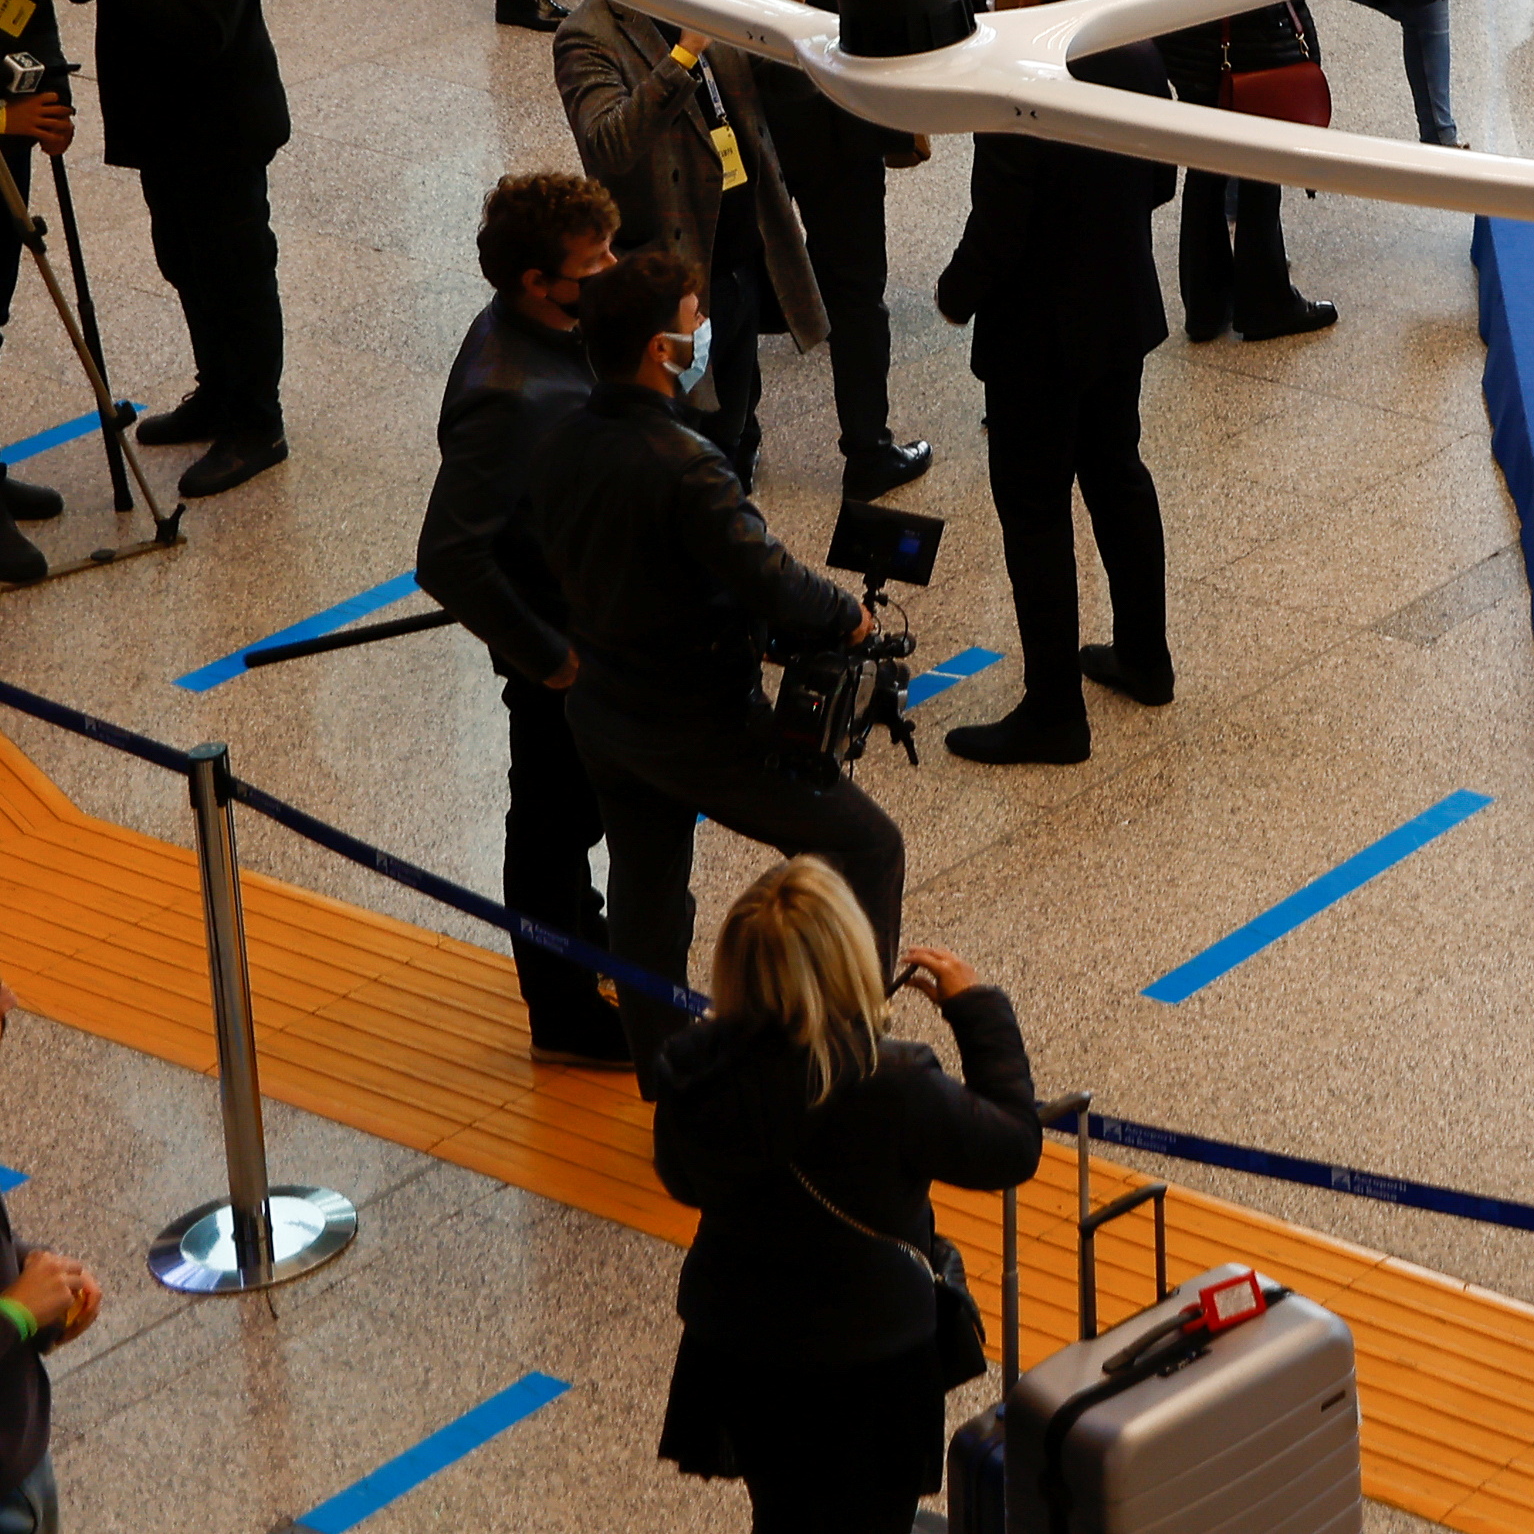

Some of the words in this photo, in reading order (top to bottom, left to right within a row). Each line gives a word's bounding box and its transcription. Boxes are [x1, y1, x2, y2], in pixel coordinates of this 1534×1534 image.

[1352, 1170, 1407, 1192] Aeroporti
[1353, 1184, 1364, 1193] di
[1365, 1185, 1398, 1202] Roma
